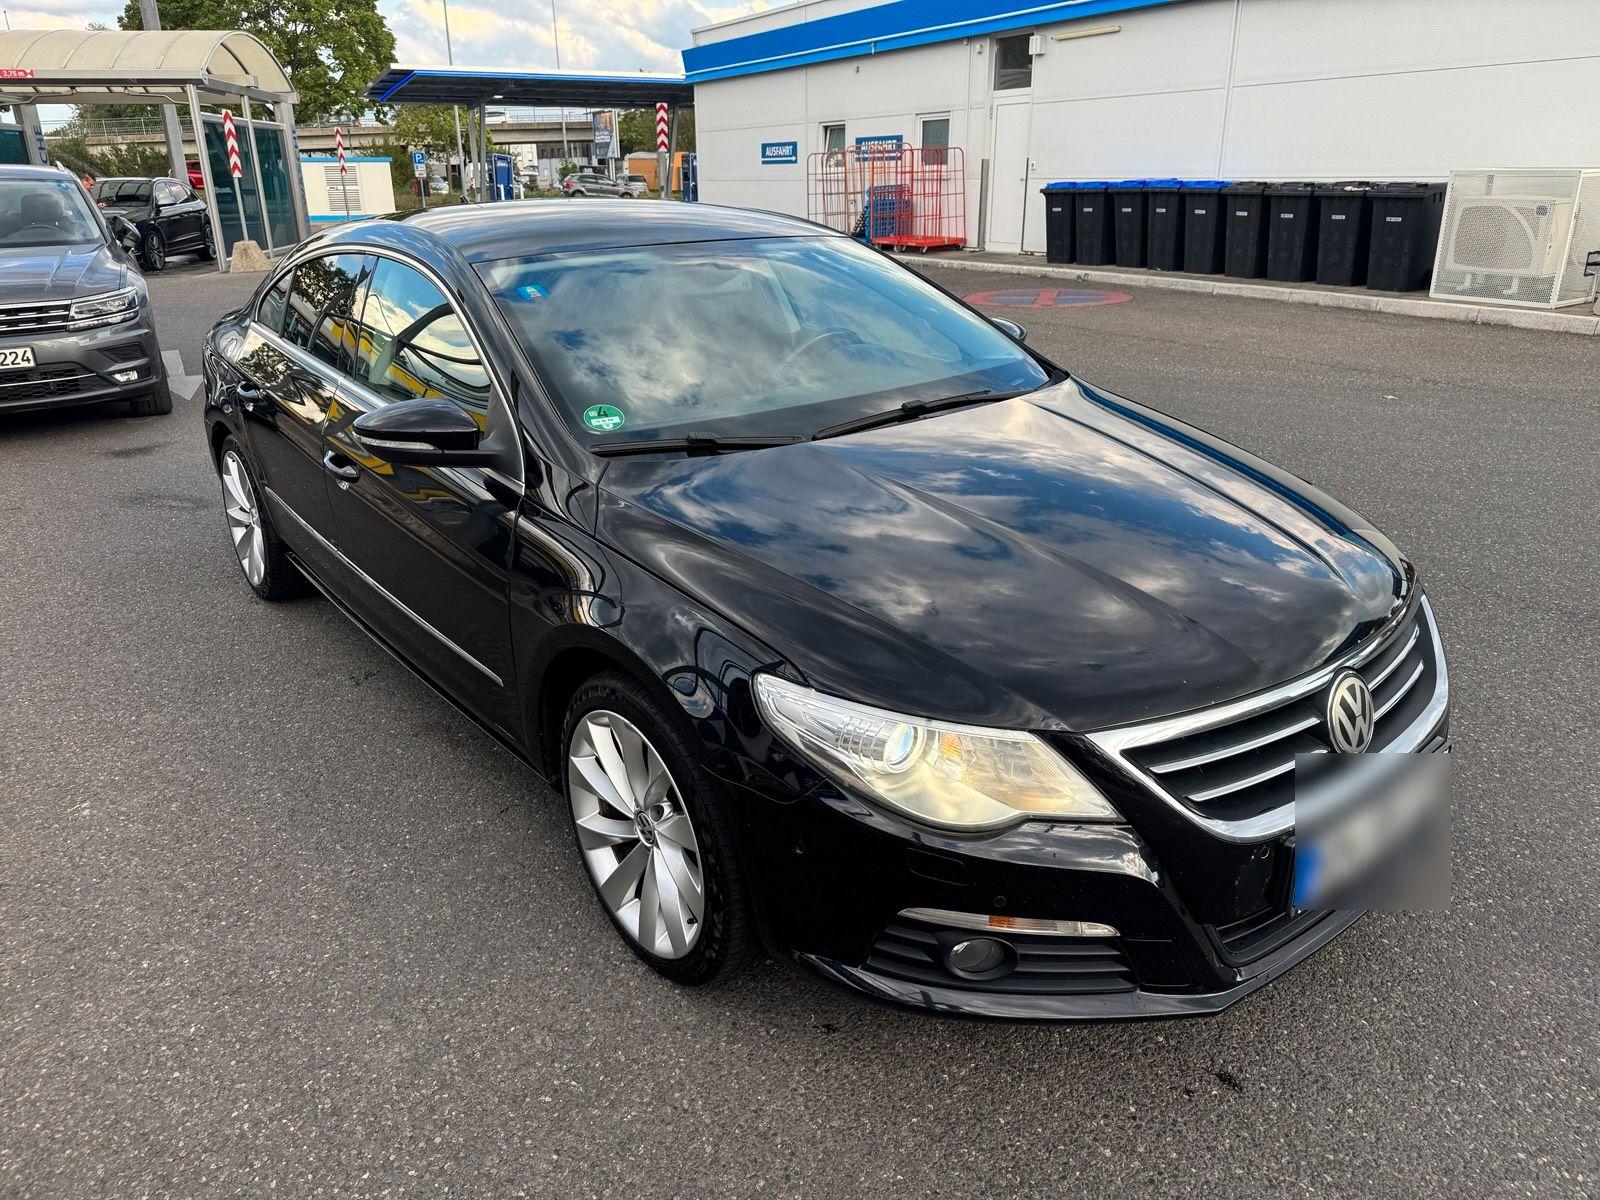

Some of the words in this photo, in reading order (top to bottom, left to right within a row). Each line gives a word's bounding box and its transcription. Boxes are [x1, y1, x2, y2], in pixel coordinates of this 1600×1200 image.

[765, 145, 793, 156] AUSFAHRT
[860, 139, 898, 151] AUSFAHRT
[0, 350, 31, 366] 224
[597, 406, 608, 417] 4
